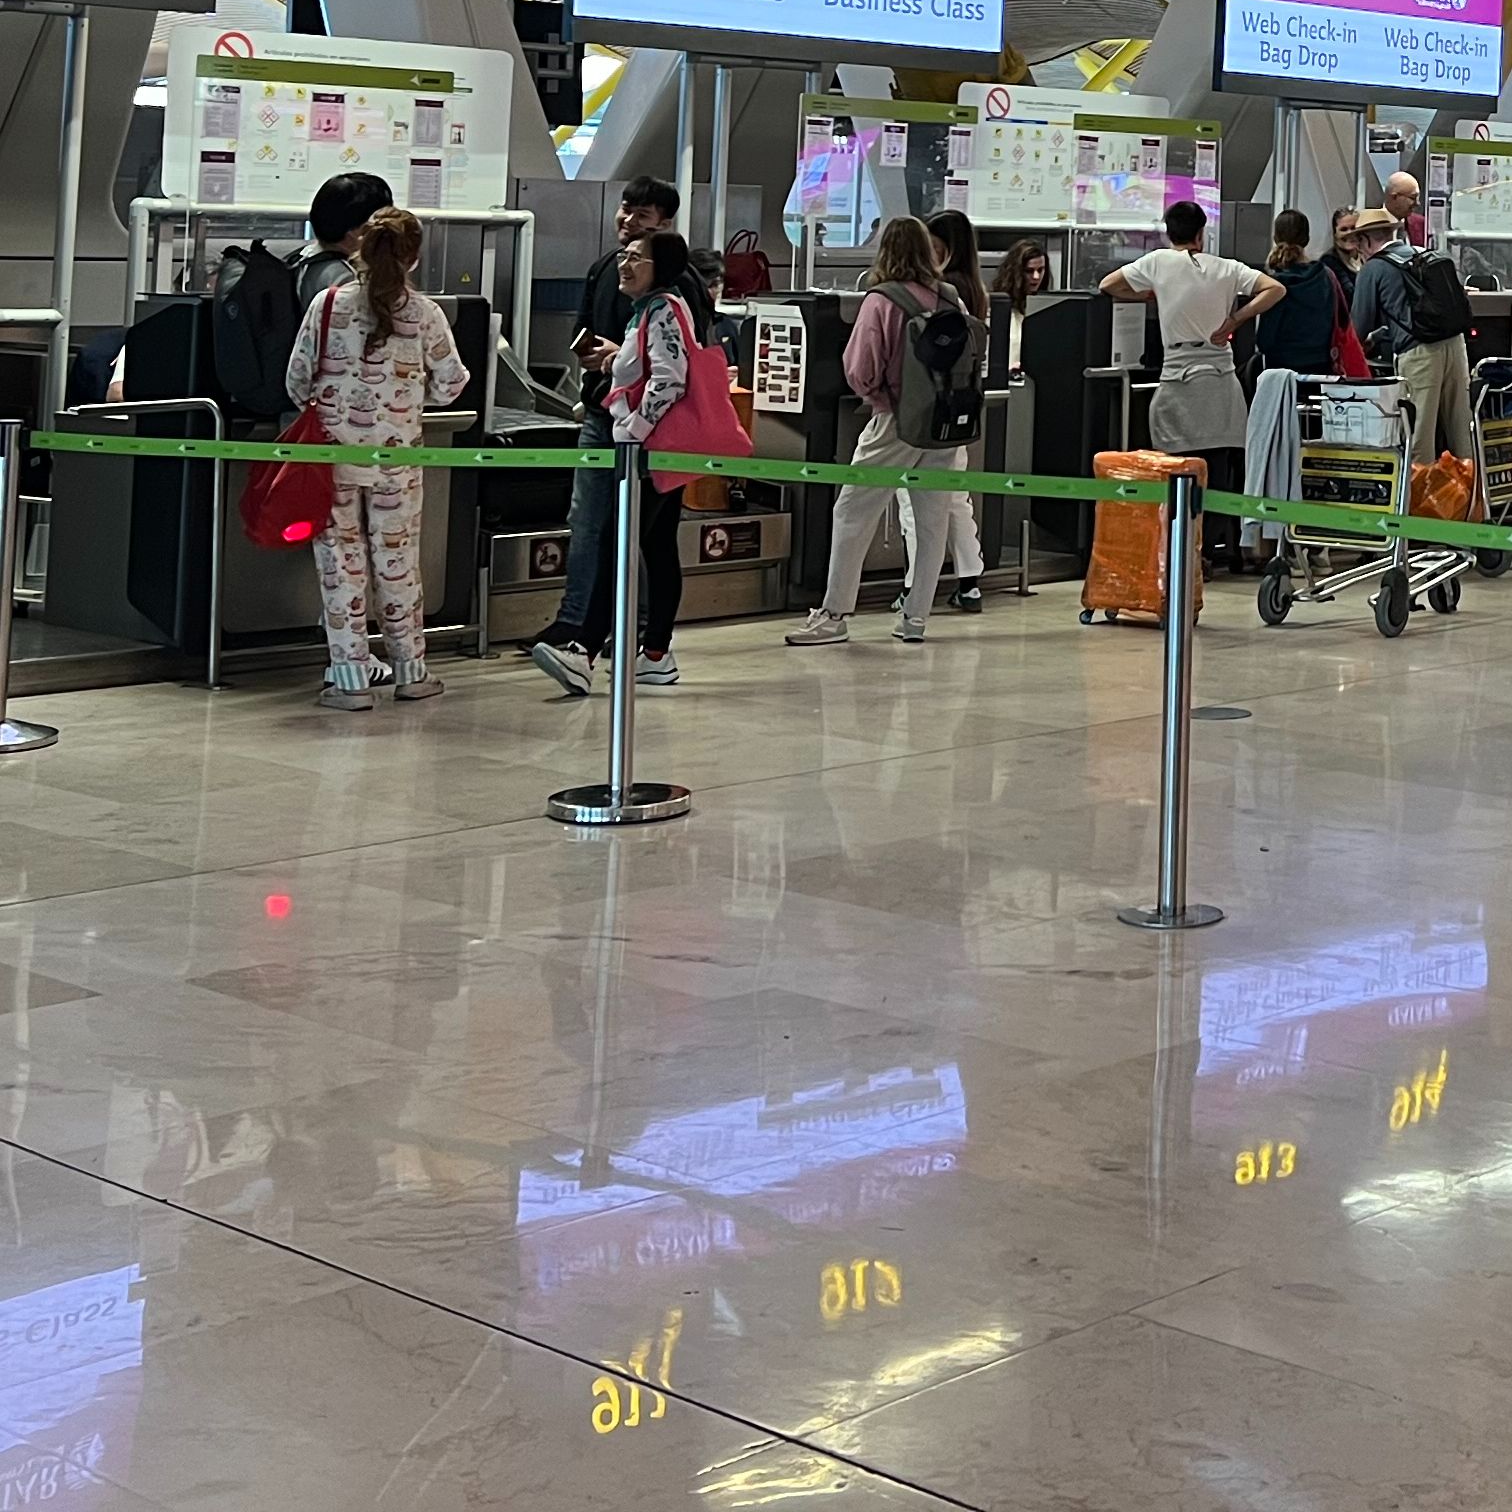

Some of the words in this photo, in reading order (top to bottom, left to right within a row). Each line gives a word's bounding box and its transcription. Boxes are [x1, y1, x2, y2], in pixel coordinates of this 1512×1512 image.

[1242, 11, 1280, 36] Web
[1286, 16, 1358, 44] Check-in
[1384, 27, 1419, 51] Web
[1424, 31, 1488, 58] Check-in
[1260, 41, 1292, 71] Bag
[1298, 45, 1339, 73] Drop
[1400, 55, 1429, 83] Bag
[1435, 59, 1471, 86] Drop
